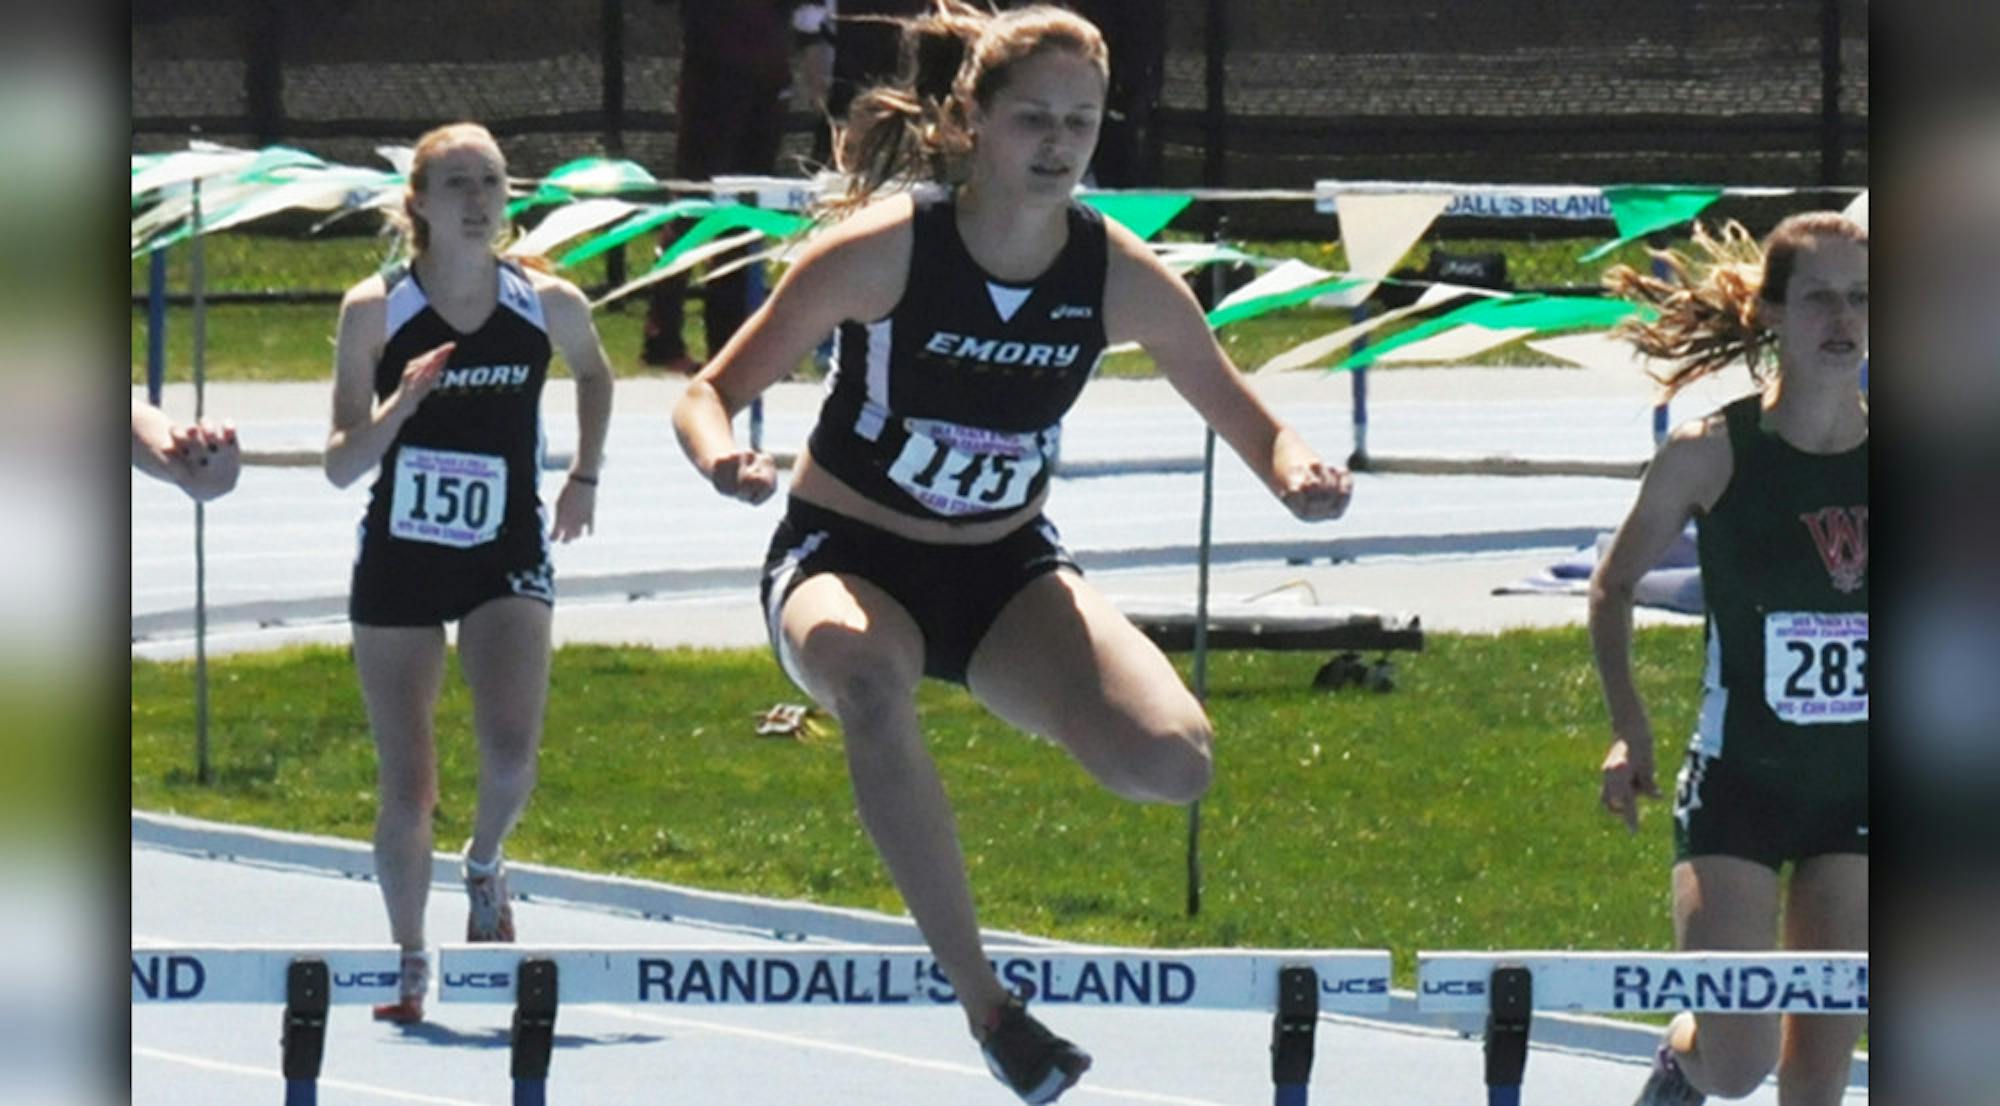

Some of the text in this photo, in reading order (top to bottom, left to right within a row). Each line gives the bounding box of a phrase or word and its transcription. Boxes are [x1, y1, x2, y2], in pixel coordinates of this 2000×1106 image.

[925, 331, 1080, 367] EMORY
[911, 438, 1021, 502] 145
[410, 472, 489, 530] 150
[334, 973, 401, 987] UCS
[445, 973, 510, 988] UCS
[990, 958, 1197, 1005] SLAND
[1322, 978, 1388, 994] UCS
[1423, 980, 1486, 995] UCS
